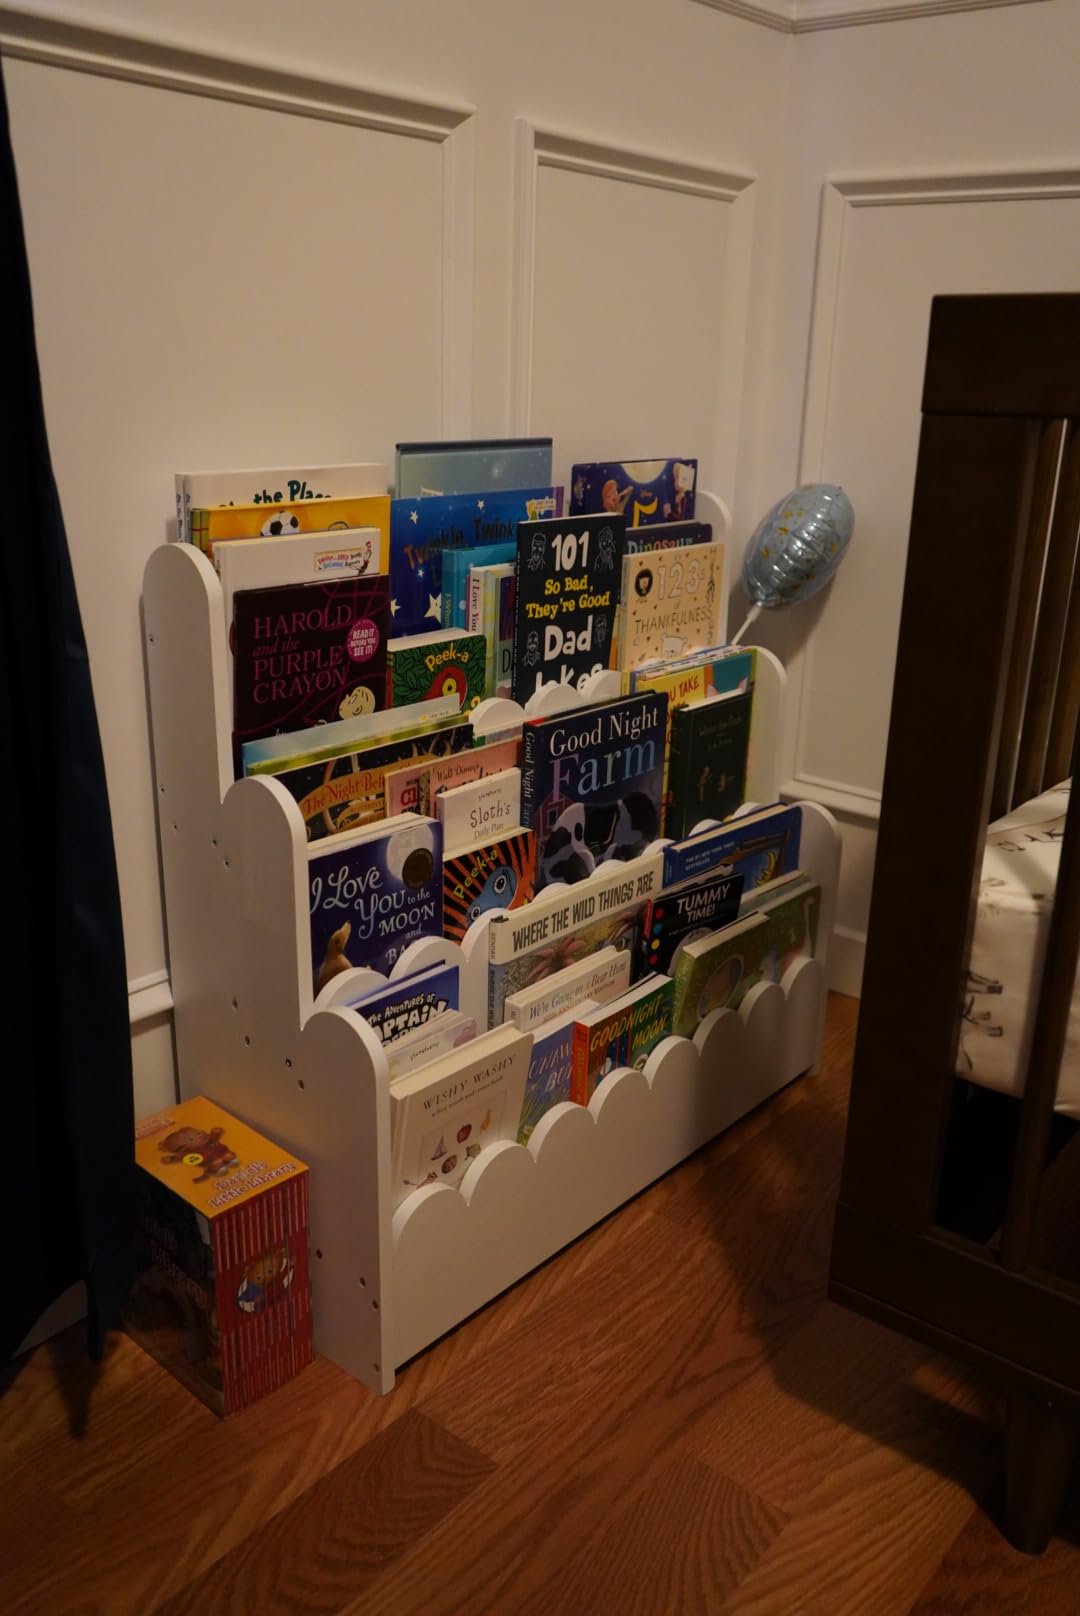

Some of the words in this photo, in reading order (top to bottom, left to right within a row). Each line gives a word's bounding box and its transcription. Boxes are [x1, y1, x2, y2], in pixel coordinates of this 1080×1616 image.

[254, 490, 283, 504] the
[288, 480, 332, 501] Pla
[472, 517, 514, 541] Twink
[551, 530, 591, 572] 101
[472, 585, 480, 611] Love
[544, 577, 561, 596] So
[564, 574, 594, 593] Bad,
[254, 604, 352, 640] HAROLD
[472, 612, 480, 632] You
[526, 597, 576, 620] They're
[578, 592, 611, 609] Good
[635, 605, 713, 634] THANKFULNESS
[252, 637, 278, 656] and
[281, 634, 301, 651] the
[352, 629, 368, 640] READ
[544, 614, 594, 662] Dad
[253, 645, 345, 681] PURPLE
[425, 640, 471, 672] Peek-a
[252, 667, 347, 704] CRAYON
[679, 675, 700, 698] TAKE
[549, 717, 603, 757] Good
[608, 704, 659, 741] Night
[523, 733, 536, 765] Good
[521, 768, 536, 799] Night
[549, 738, 657, 802] Farm
[302, 797, 326, 815] The
[326, 778, 360, 801] Night
[470, 800, 511, 828] Sloth's
[407, 895, 417, 905] to
[417, 888, 431, 902] the
[512, 918, 549, 953] WHERE
[552, 907, 570, 934] THE
[572, 896, 596, 924] WILD
[598, 881, 635, 913] THINGS
[636, 870, 655, 897] ARE
[676, 883, 732, 915] TUMMY
[378, 902, 436, 937] MOON
[686, 904, 717, 924] TIME!
[405, 924, 423, 940] and
[590, 995, 663, 1052] GOODNIGHT
[632, 1014, 668, 1051] MOON
[423, 1079, 468, 1112] WISHY
[473, 1053, 517, 1083] WASHY
